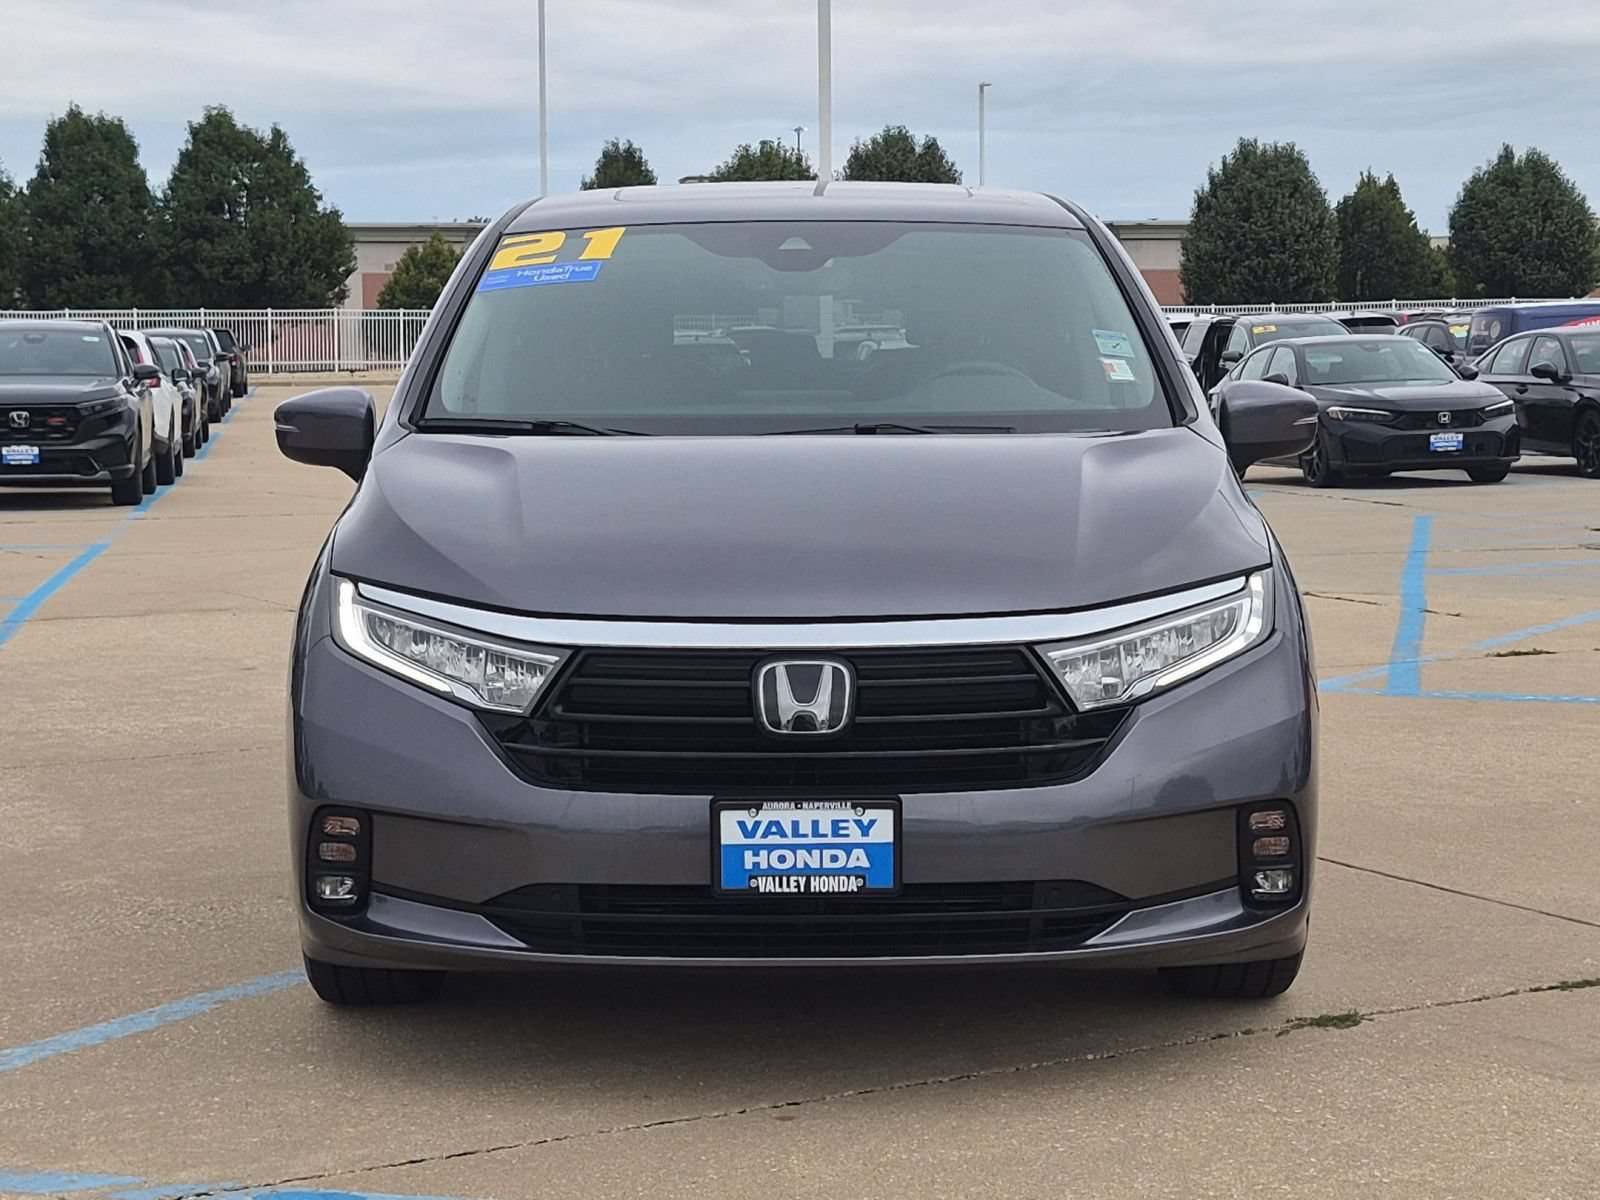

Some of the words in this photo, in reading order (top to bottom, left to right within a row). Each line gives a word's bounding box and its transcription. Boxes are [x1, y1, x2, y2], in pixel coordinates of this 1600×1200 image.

[762, 802, 796, 810] AURORA
[803, 801, 852, 810] NAPERVILLE
[736, 819, 878, 839] VALLEY
[744, 848, 870, 870] HONDA
[757, 876, 806, 892] VALLEY
[810, 876, 858, 892] HONDA
